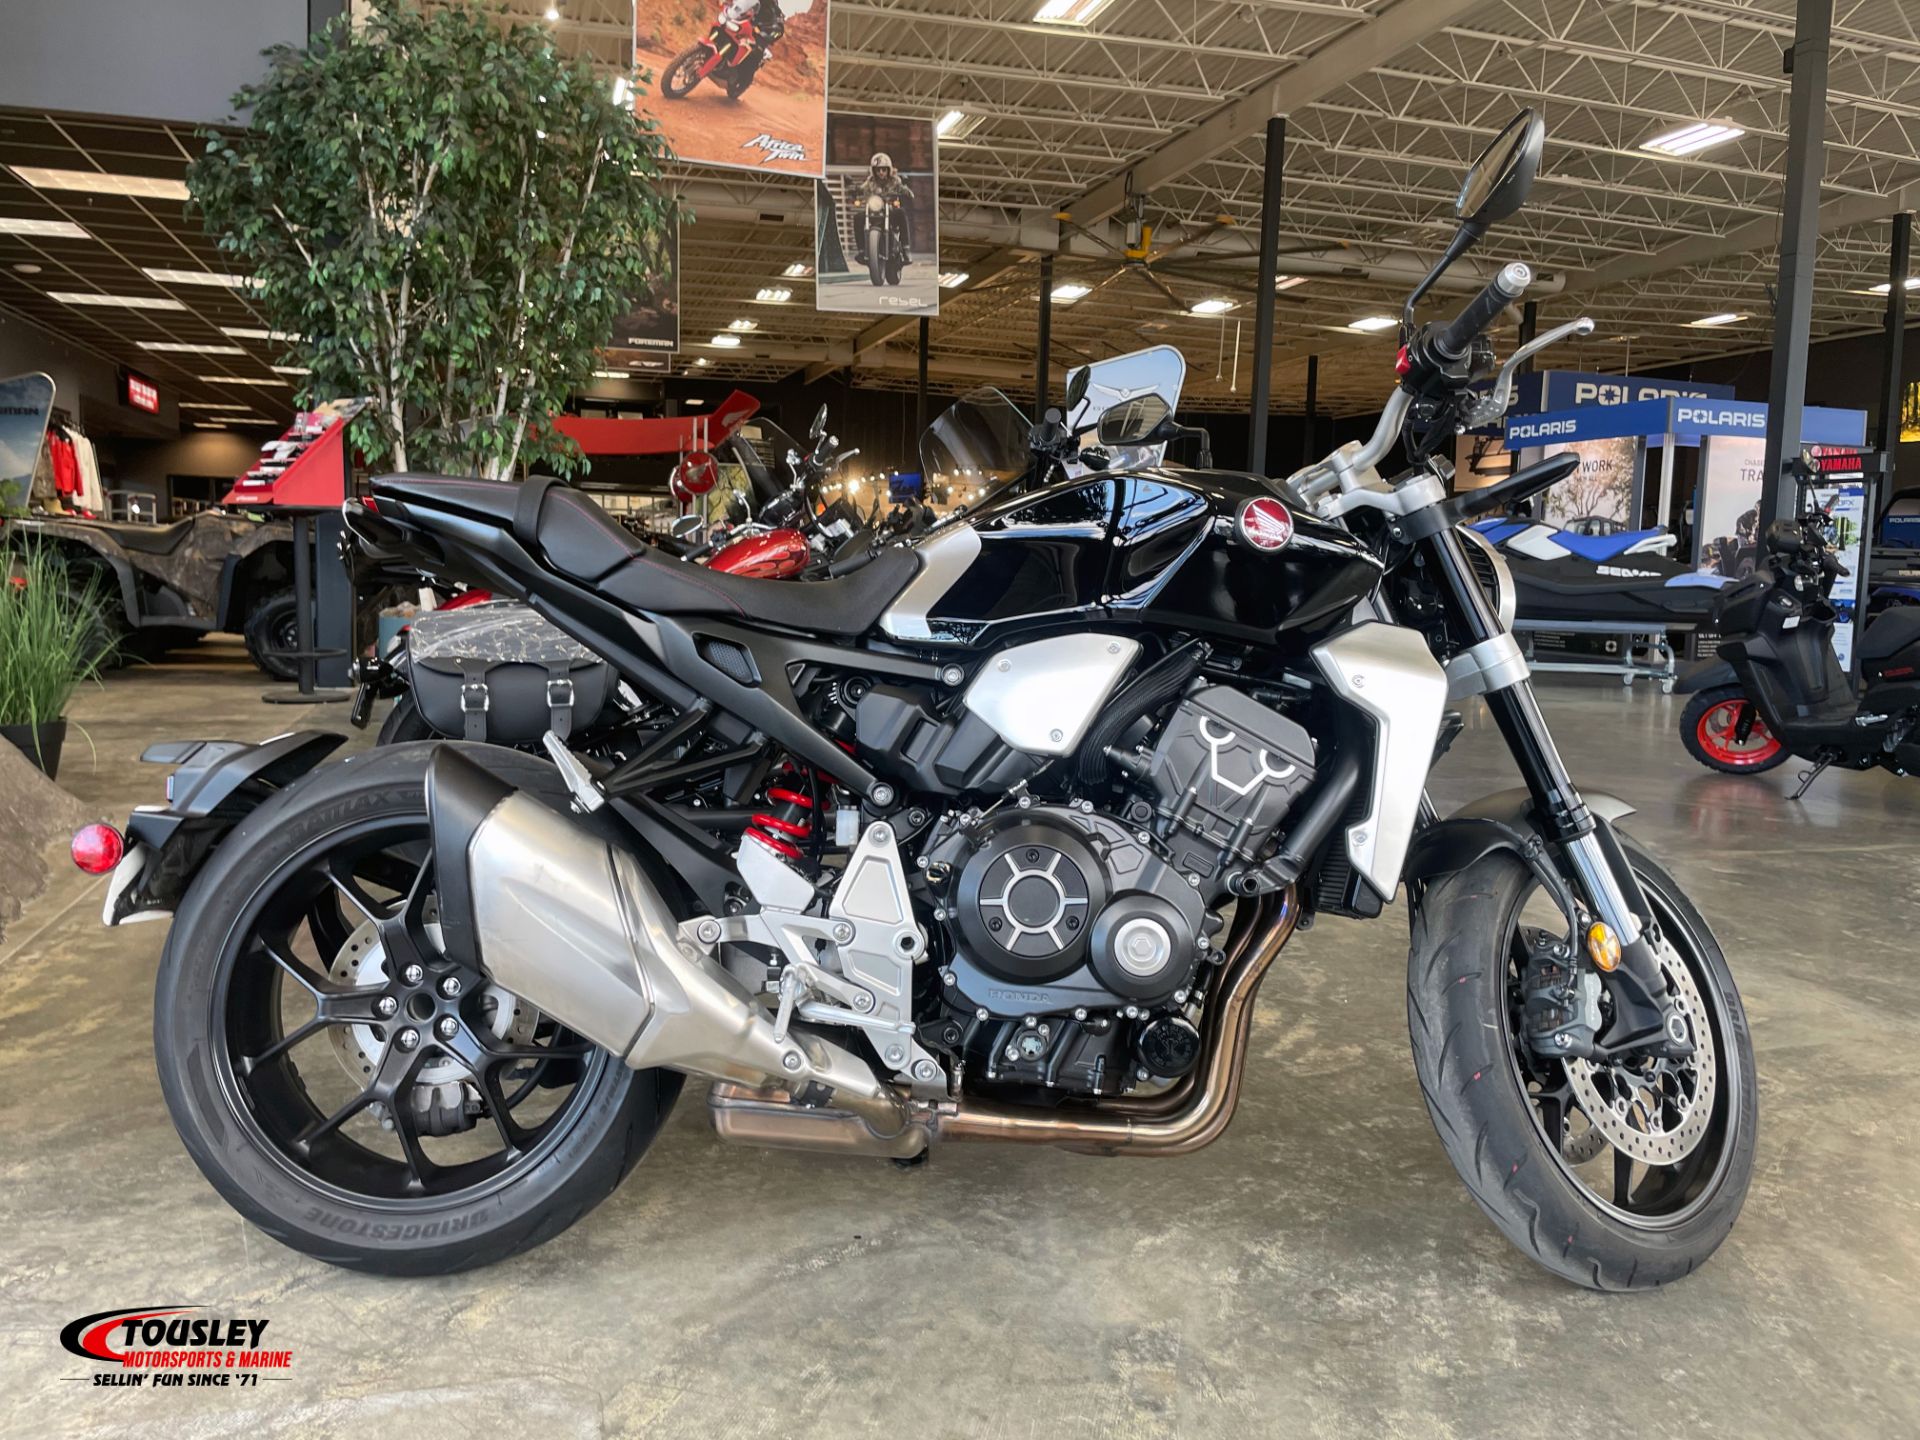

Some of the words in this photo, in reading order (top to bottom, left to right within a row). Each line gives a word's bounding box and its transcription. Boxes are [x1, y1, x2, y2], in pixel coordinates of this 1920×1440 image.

[742, 133, 804, 152] Africa
[762, 149, 806, 163] Twin
[628, 337, 674, 347] FOREMAN
[1575, 382, 1708, 406] POLA
[1678, 408, 1766, 428] POLARIS
[1509, 419, 1577, 440] POLARIS
[1582, 459, 1613, 472] WORK
[1821, 457, 1862, 472] YAMAHA
[988, 988, 1054, 1004] HONDA
[303, 1206, 490, 1243] BRIDGESTONE
